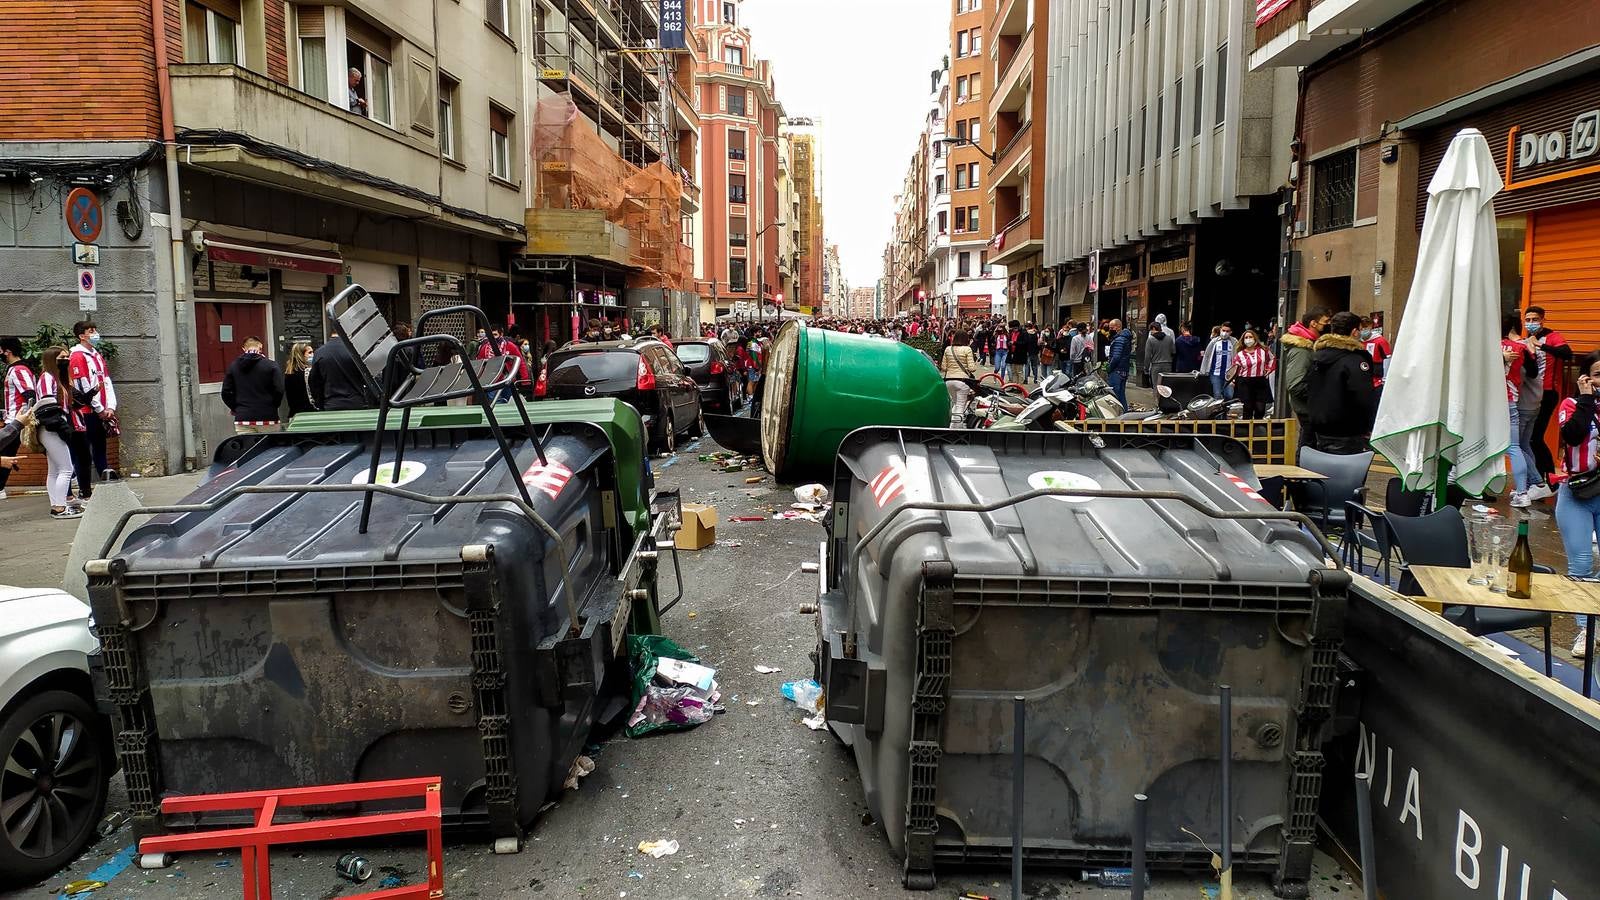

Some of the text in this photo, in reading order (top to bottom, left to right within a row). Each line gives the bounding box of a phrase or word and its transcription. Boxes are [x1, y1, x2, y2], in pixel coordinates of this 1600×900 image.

[663, 0, 682, 10] 944
[663, 11, 682, 21] 413
[663, 22, 682, 32] 962
